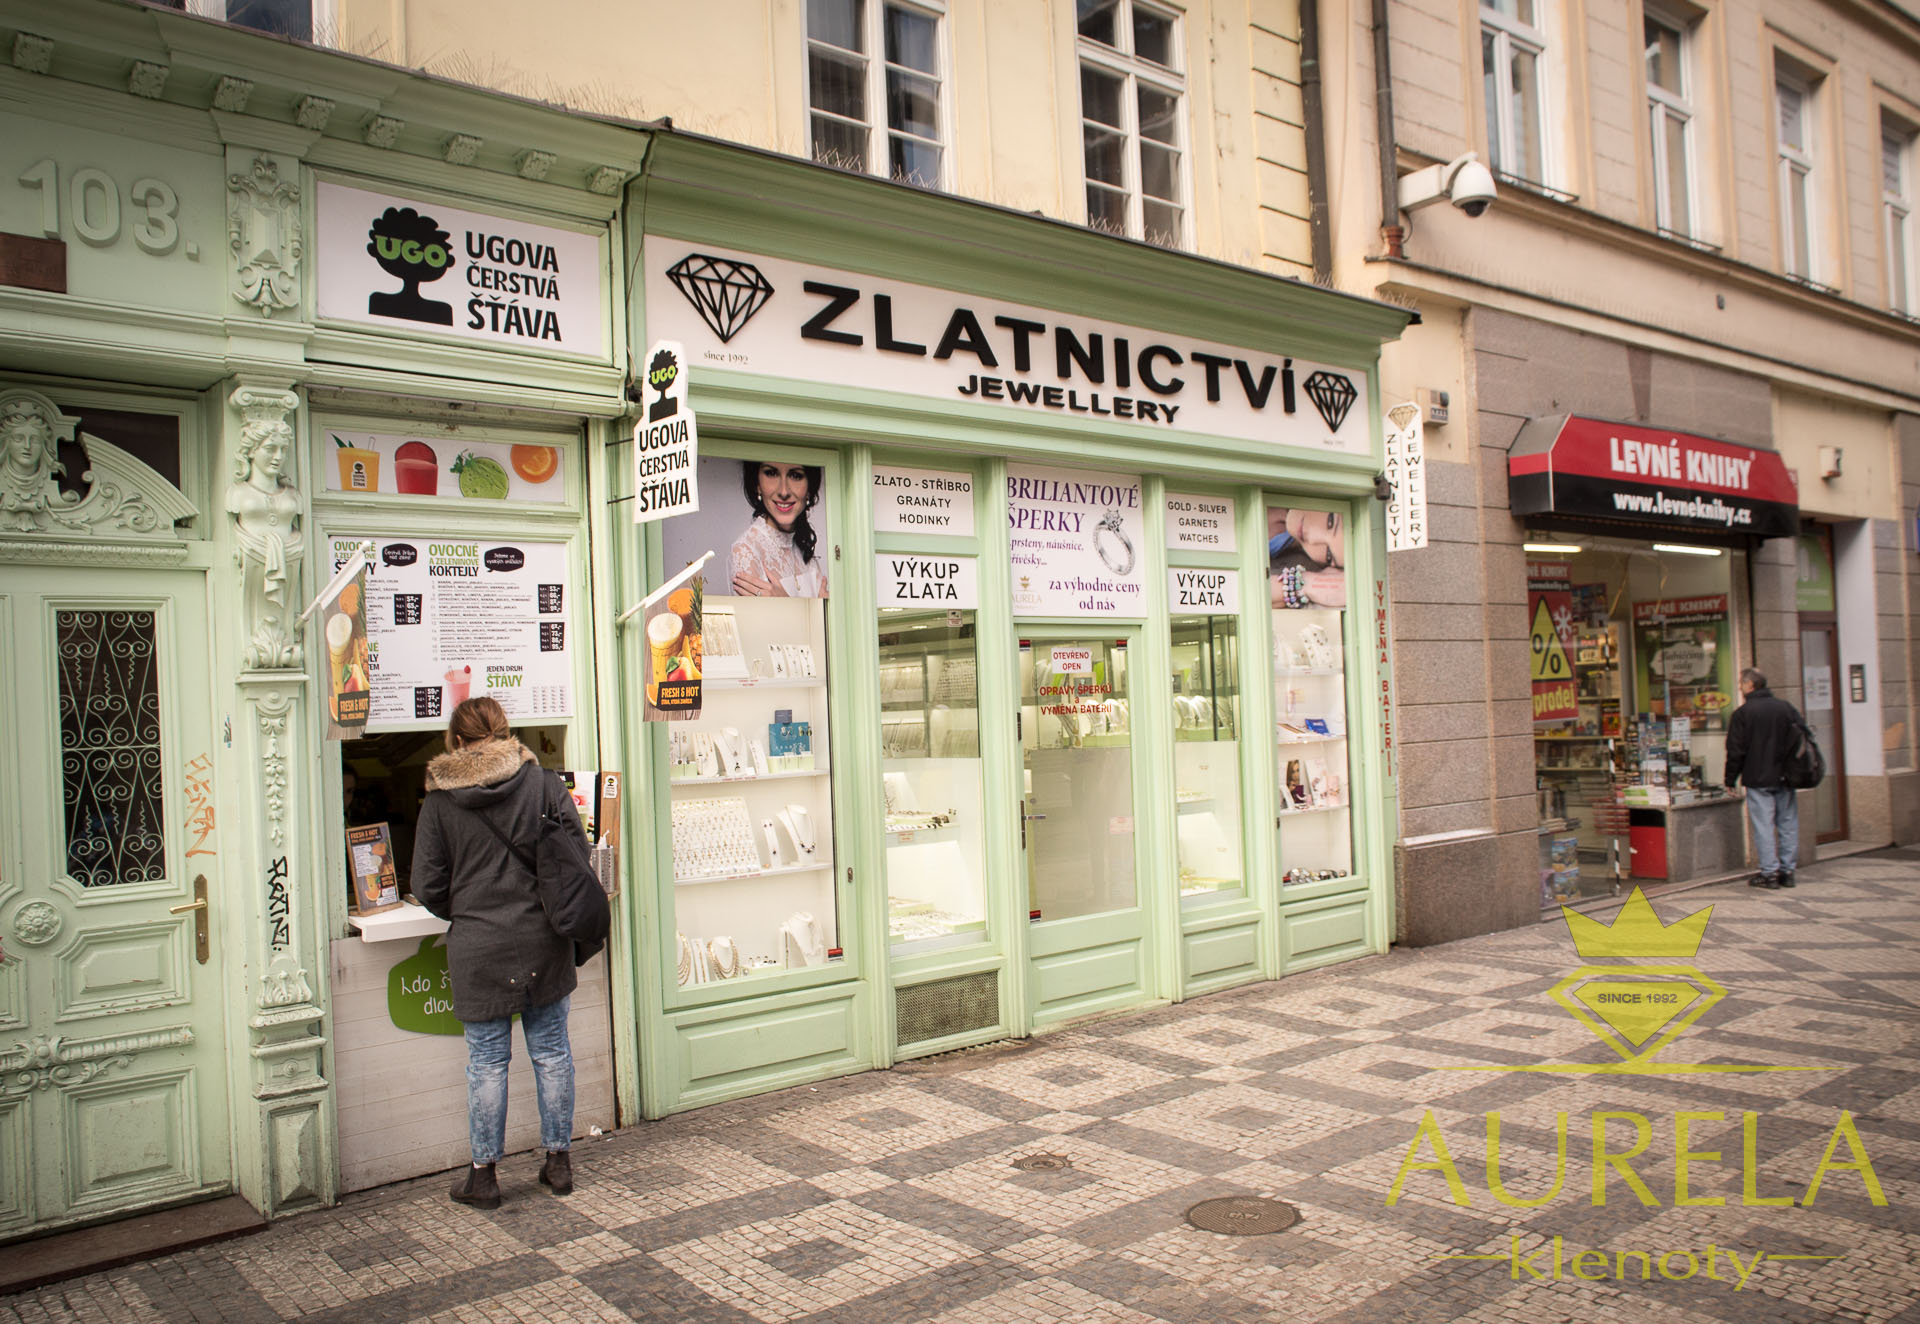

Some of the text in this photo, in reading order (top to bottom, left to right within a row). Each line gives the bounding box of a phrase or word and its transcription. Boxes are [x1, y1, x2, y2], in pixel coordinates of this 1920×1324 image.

[374, 235, 448, 268] UGO
[465, 230, 560, 274] UGOVA
[466, 260, 561, 301] ČERSTVÁ
[467, 291, 562, 342] ŠŤÁVA
[800, 279, 1297, 415] ZLATNICTVÍ
[704, 350, 749, 366] since 1992
[651, 364, 676, 385] UGO
[957, 374, 1180, 424] JEWELLERY
[639, 419, 689, 452] UGOVA
[639, 445, 690, 478] ČERSTVÁ
[1609, 437, 1752, 490] LEVNÉ KNIHY
[874, 475, 912, 488] ZLATO
[921, 478, 971, 493] STŘÍBRO
[1007, 477, 1139, 508] BRILIANTOVÉ
[1405, 429, 1421, 546] JEWELLERY
[640, 476, 691, 513] ŠŤÁVA
[896, 495, 951, 509] GRANÁTY
[1008, 502, 1086, 533] ŠPERKY
[1167, 500, 1192, 512] GOLD
[1198, 503, 1228, 515] SILVER
[1612, 490, 1753, 527] www.levneknihy.cz
[899, 513, 951, 526] HODINKY
[1178, 517, 1219, 529] GARNETS
[1179, 533, 1220, 544] WATCHES
[428, 542, 479, 557] OVOCNÉ
[428, 565, 480, 577] KOKTEJLY
[892, 557, 960, 580] VÝKUP
[1049, 576, 1142, 598] za výhodné ceny
[1176, 570, 1226, 590] VÝKUP
[896, 582, 958, 600] ZLATA
[1179, 590, 1225, 606] ZLATA
[1079, 595, 1116, 611] od nás
[1053, 650, 1090, 660] OTEVŘENO
[1062, 662, 1082, 671] OPEN
[487, 672, 523, 688] ŠŤÁVY
[1039, 682, 1112, 697] OPRAVY ŠPERKŮ
[661, 687, 680, 698] FRESH
[686, 686, 699, 697] HOT
[1533, 683, 1576, 718] prodej
[1040, 704, 1077, 716] VÝMĚNA
[401, 974, 431, 995] kdo
